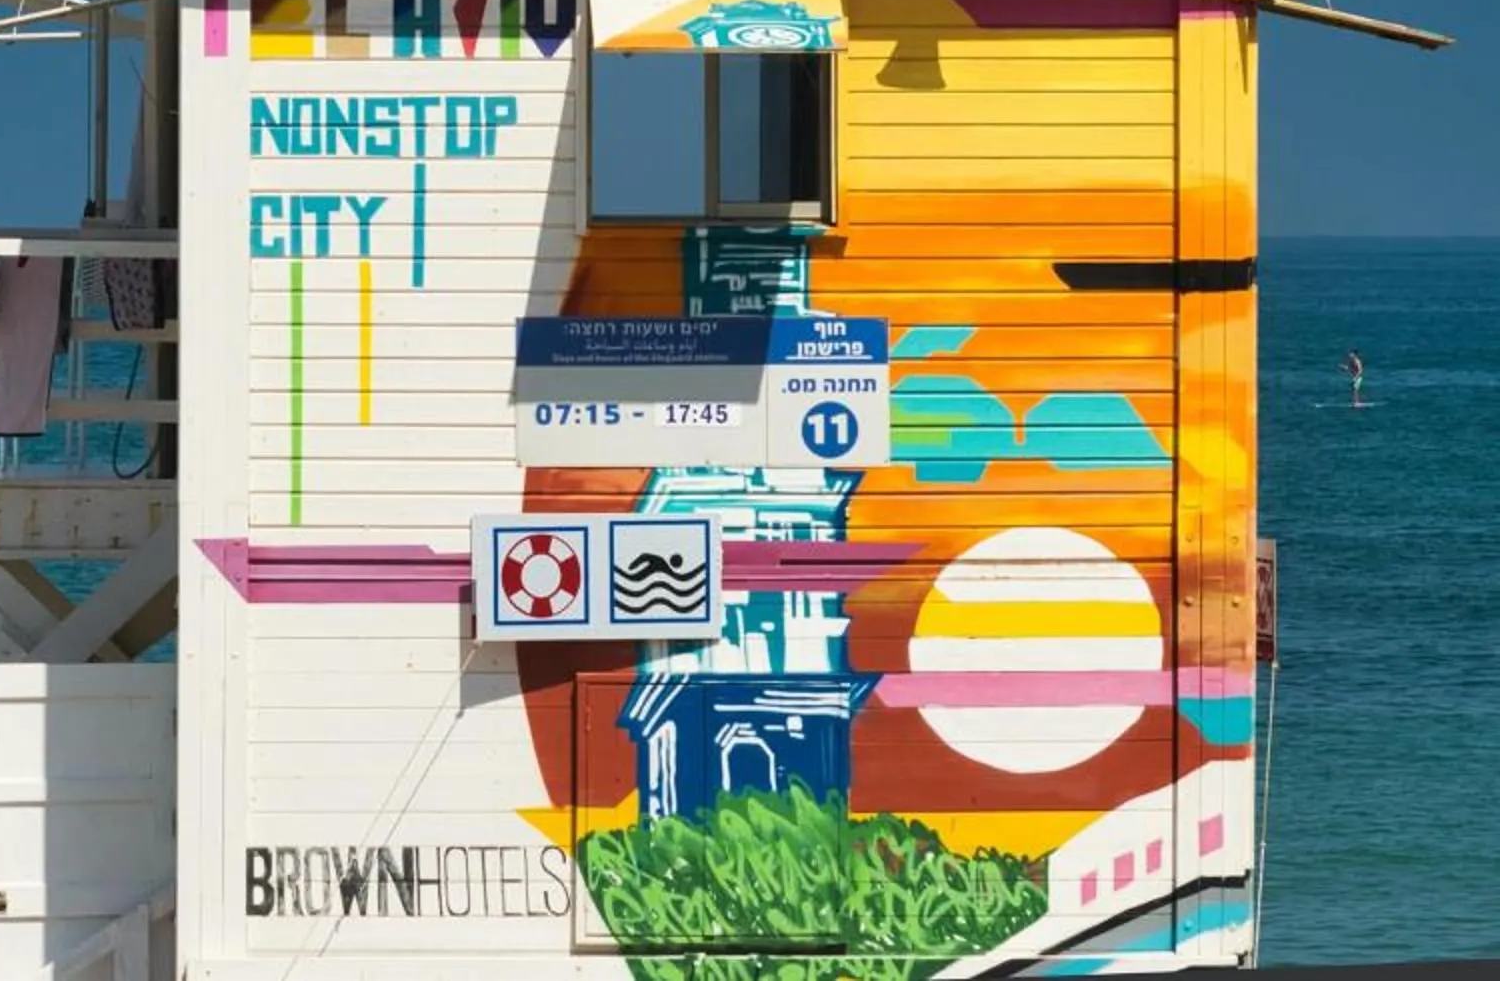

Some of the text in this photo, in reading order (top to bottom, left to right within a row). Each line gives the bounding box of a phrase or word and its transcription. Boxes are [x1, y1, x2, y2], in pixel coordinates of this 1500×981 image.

[250, 97, 518, 158] NONSTOP
[250, 196, 388, 258] CITY
[680, 322, 718, 336] ימים
[813, 321, 847, 340] חוף
[797, 341, 865, 358] פרישמן
[781, 378, 877, 394] תחנה מס.
[535, 403, 621, 425] 07:15
[665, 403, 729, 424] 17:45
[807, 413, 849, 445] 11
